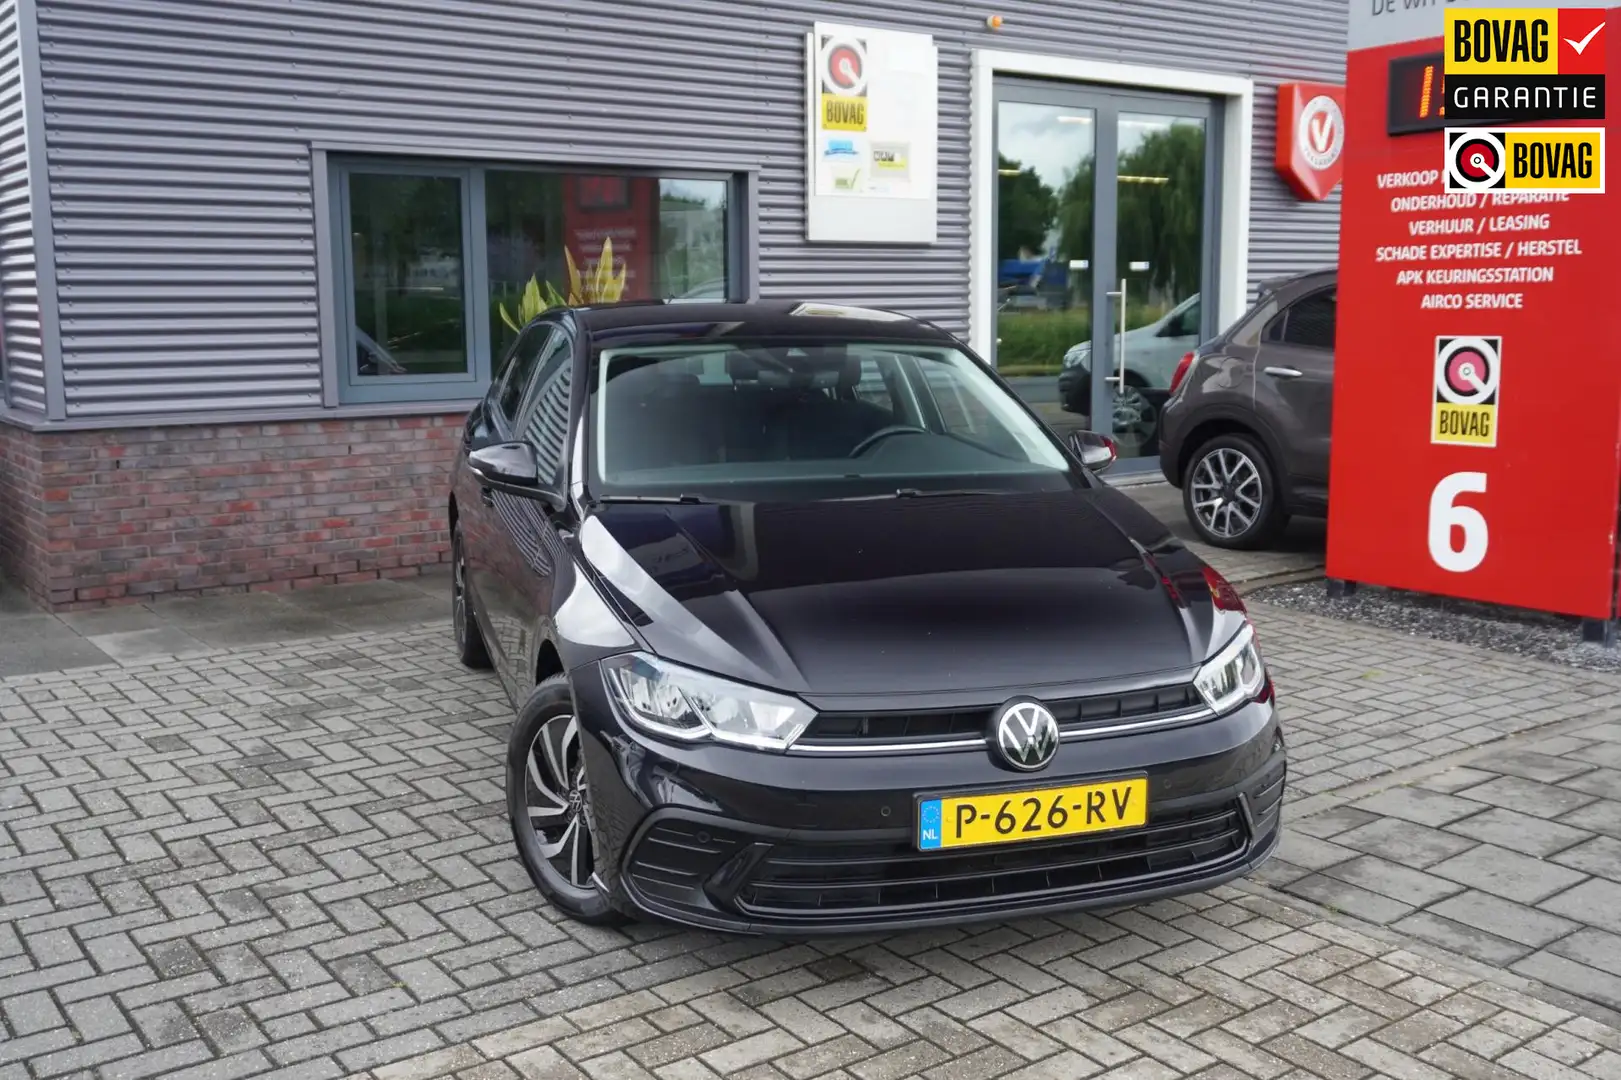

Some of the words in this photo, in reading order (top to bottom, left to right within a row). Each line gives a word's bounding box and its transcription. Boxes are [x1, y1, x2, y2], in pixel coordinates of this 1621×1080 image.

[826, 100, 864, 125] BOVAG
[1377, 169, 1439, 189] VERKOOP
[1391, 193, 1477, 213] ONDERHOUD
[1409, 219, 1474, 237] VERHUUR
[1476, 217, 1486, 235] /
[1489, 214, 1550, 232] LEASING
[1376, 244, 1427, 262] SCHADE
[1430, 242, 1502, 260] EXPERTISE
[1504, 242, 1514, 259] /
[1517, 239, 1582, 257] HERSTEL
[1396, 269, 1423, 285] APK
[1426, 266, 1554, 284] KEURINGSSTATION
[1421, 294, 1462, 309] AIRCO
[1465, 293, 1523, 309] SERVICE
[1439, 410, 1490, 437] BOVAG
[1428, 471, 1489, 572] 6
[922, 829, 939, 841] NL
[955, 786, 1132, 839] P-626-RV
